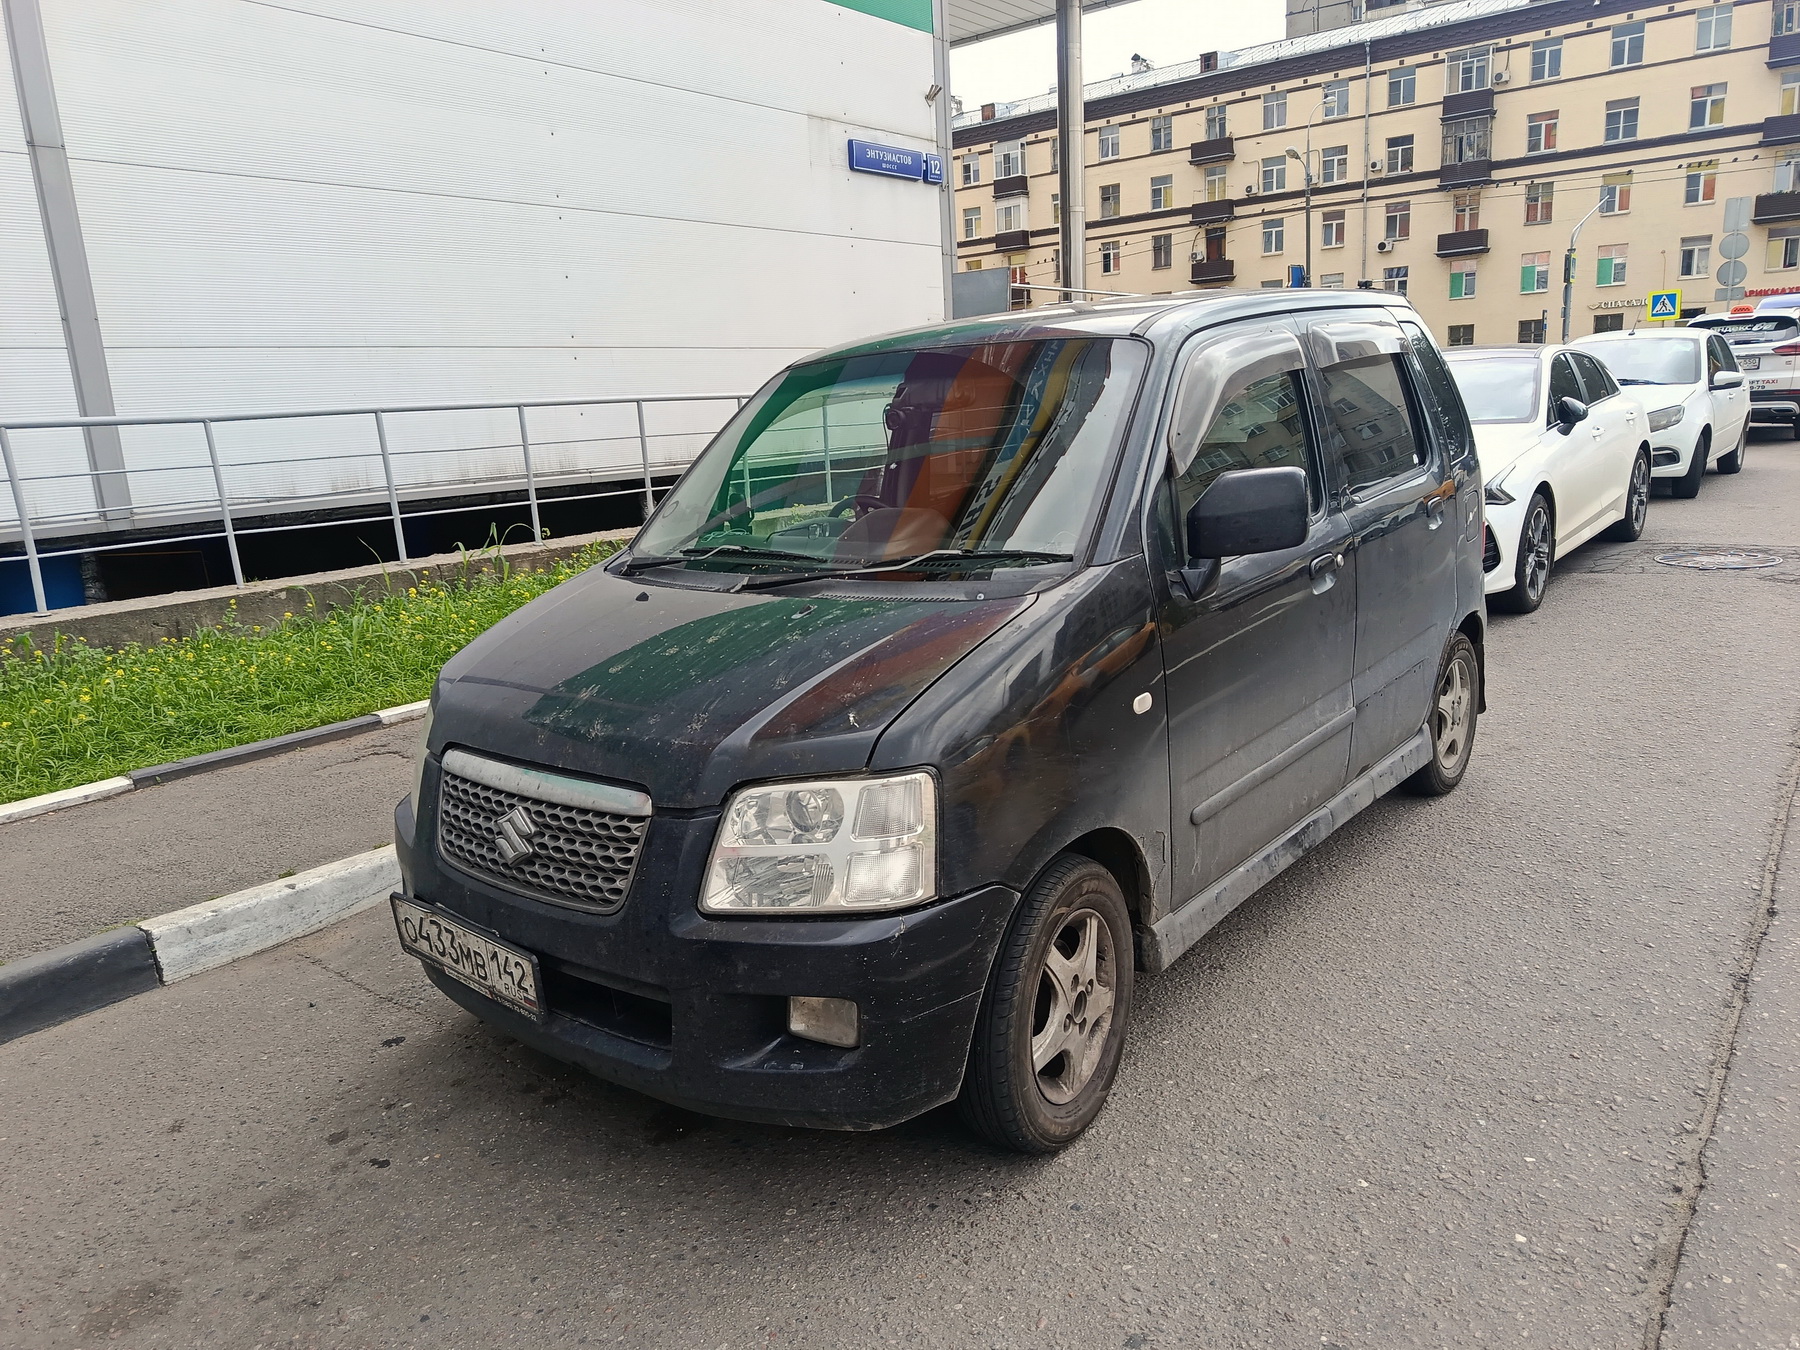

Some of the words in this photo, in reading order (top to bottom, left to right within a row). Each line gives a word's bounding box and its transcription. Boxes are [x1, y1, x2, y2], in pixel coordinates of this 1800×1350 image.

[866, 149, 911, 165] ЭНТУЗИАСТОВ
[930, 160, 941, 174] 12
[1601, 300, 1622, 309] СПА
[504, 982, 523, 1000] RUS
